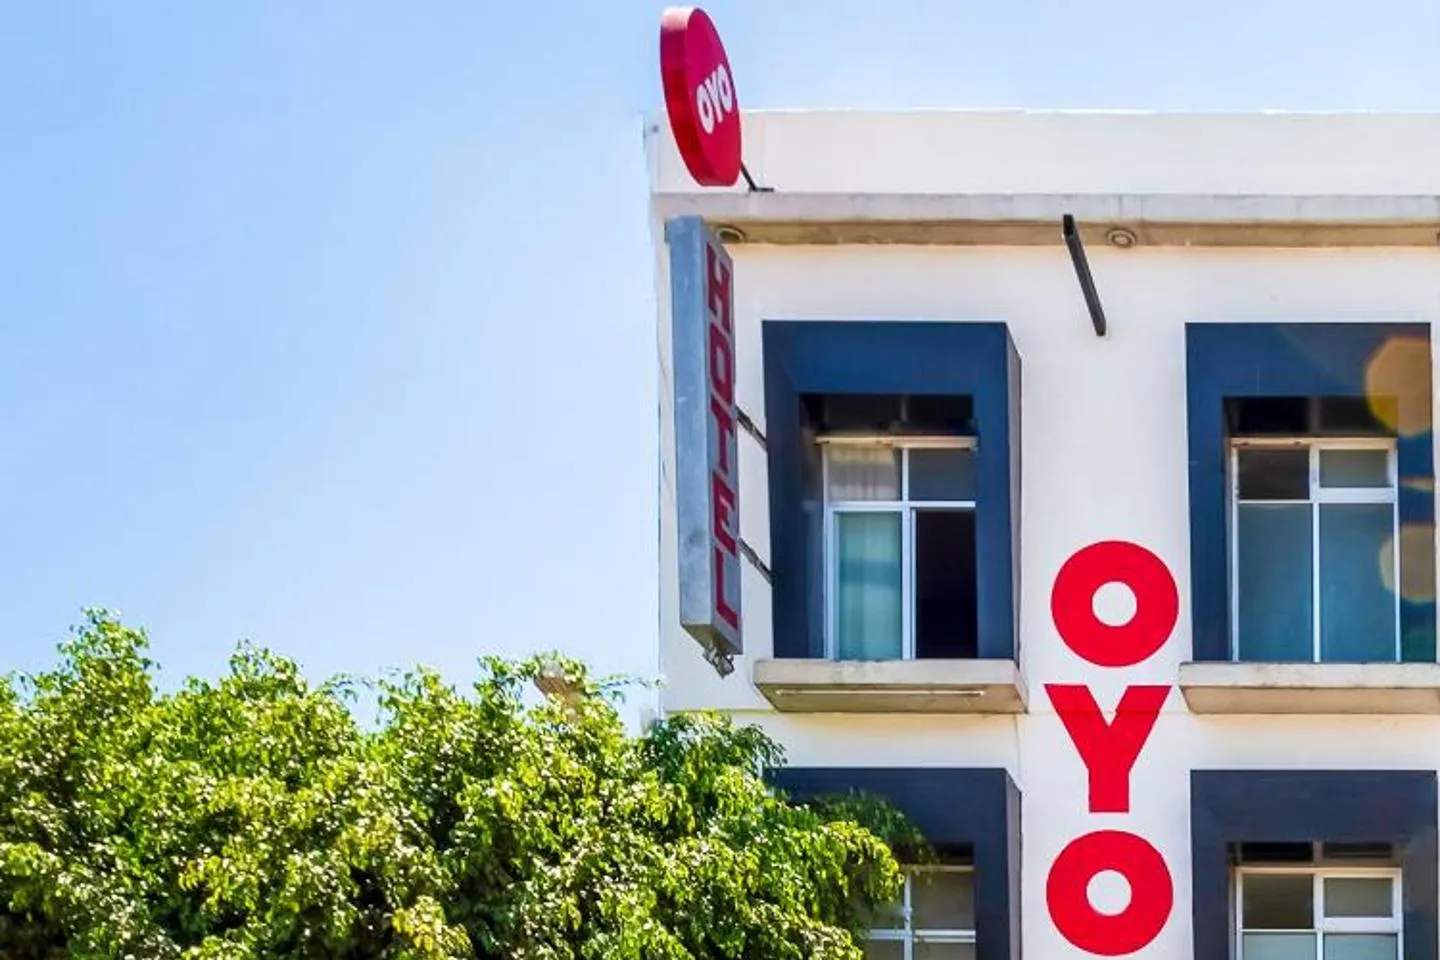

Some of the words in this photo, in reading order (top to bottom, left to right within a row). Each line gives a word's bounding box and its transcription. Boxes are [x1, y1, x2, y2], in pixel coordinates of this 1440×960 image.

[696, 63, 733, 134] OYO
[706, 242, 739, 631] HOTEL
[1044, 540, 1179, 956] OYO
